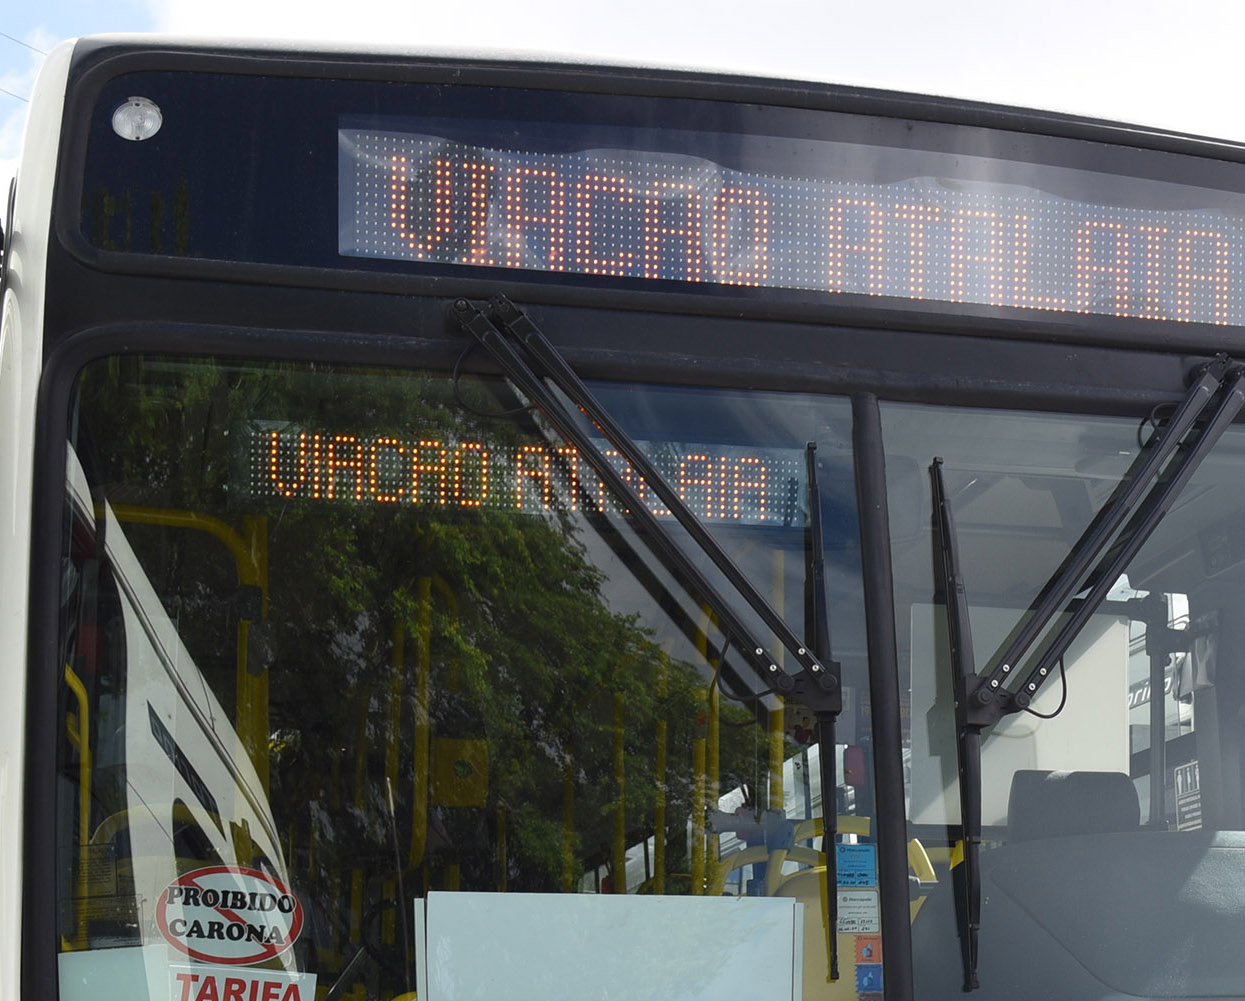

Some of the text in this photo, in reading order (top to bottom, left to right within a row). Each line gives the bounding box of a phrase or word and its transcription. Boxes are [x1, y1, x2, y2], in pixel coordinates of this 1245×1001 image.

[391, 155, 1230, 326] VIACAO ATALAIA
[270, 432, 488, 506] VIACAO
[166, 886, 296, 914] PROIBIDO
[169, 918, 285, 945] CARONA
